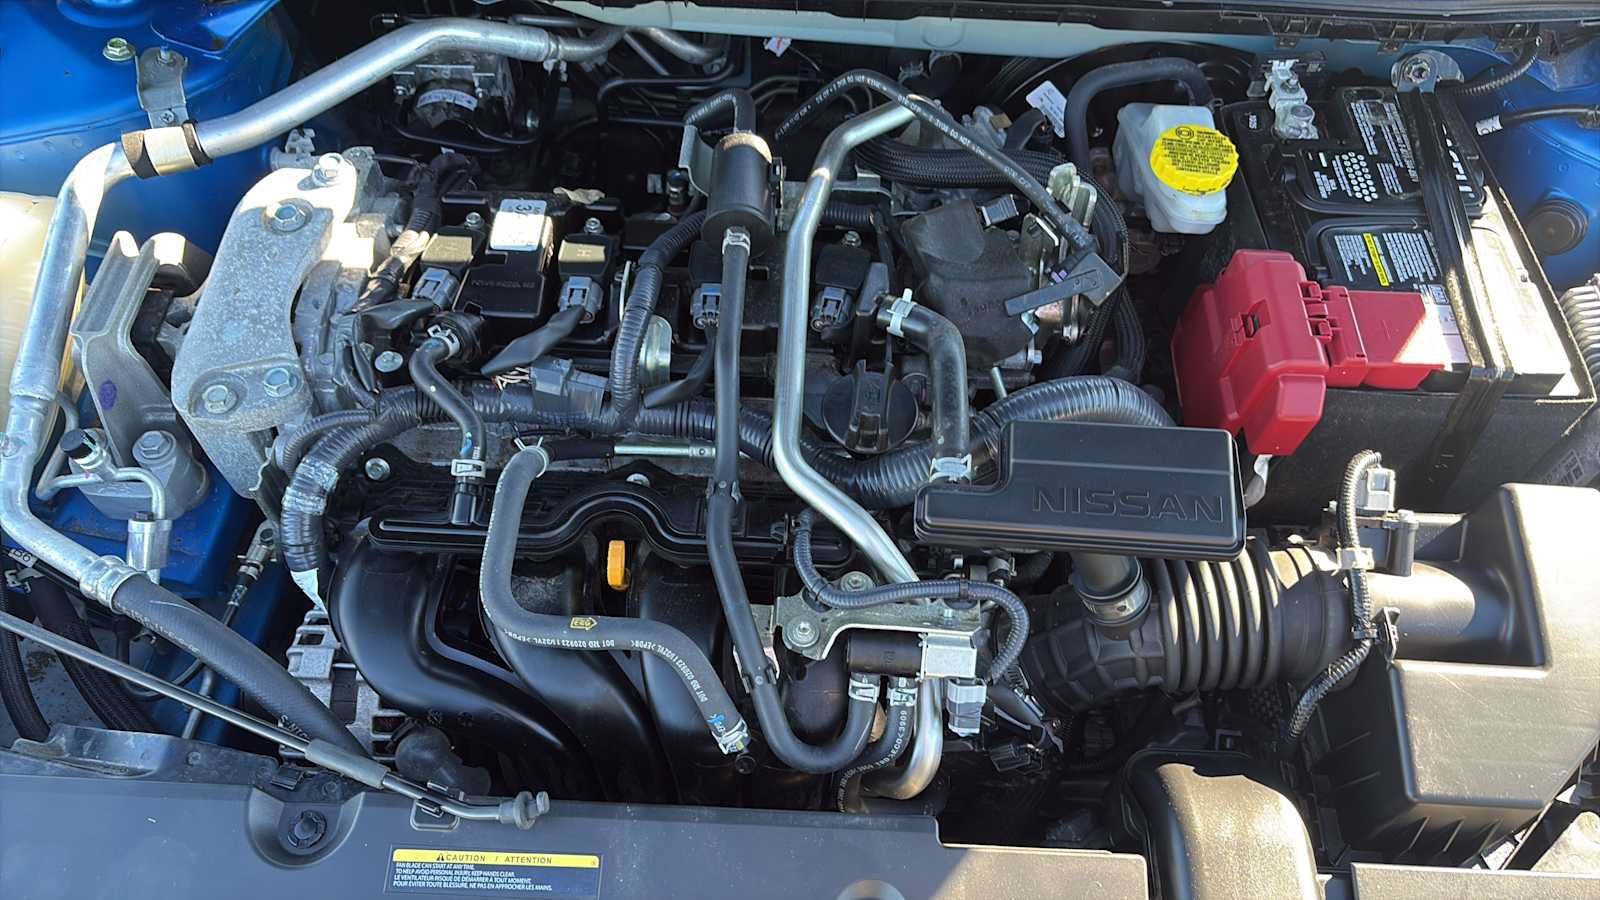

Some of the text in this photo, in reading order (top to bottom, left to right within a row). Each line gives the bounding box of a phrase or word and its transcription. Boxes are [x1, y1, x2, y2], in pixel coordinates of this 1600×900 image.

[1032, 487, 1224, 523] NISSAN
[445, 854, 486, 862] CAUTION
[504, 856, 553, 865] ATTENTION
